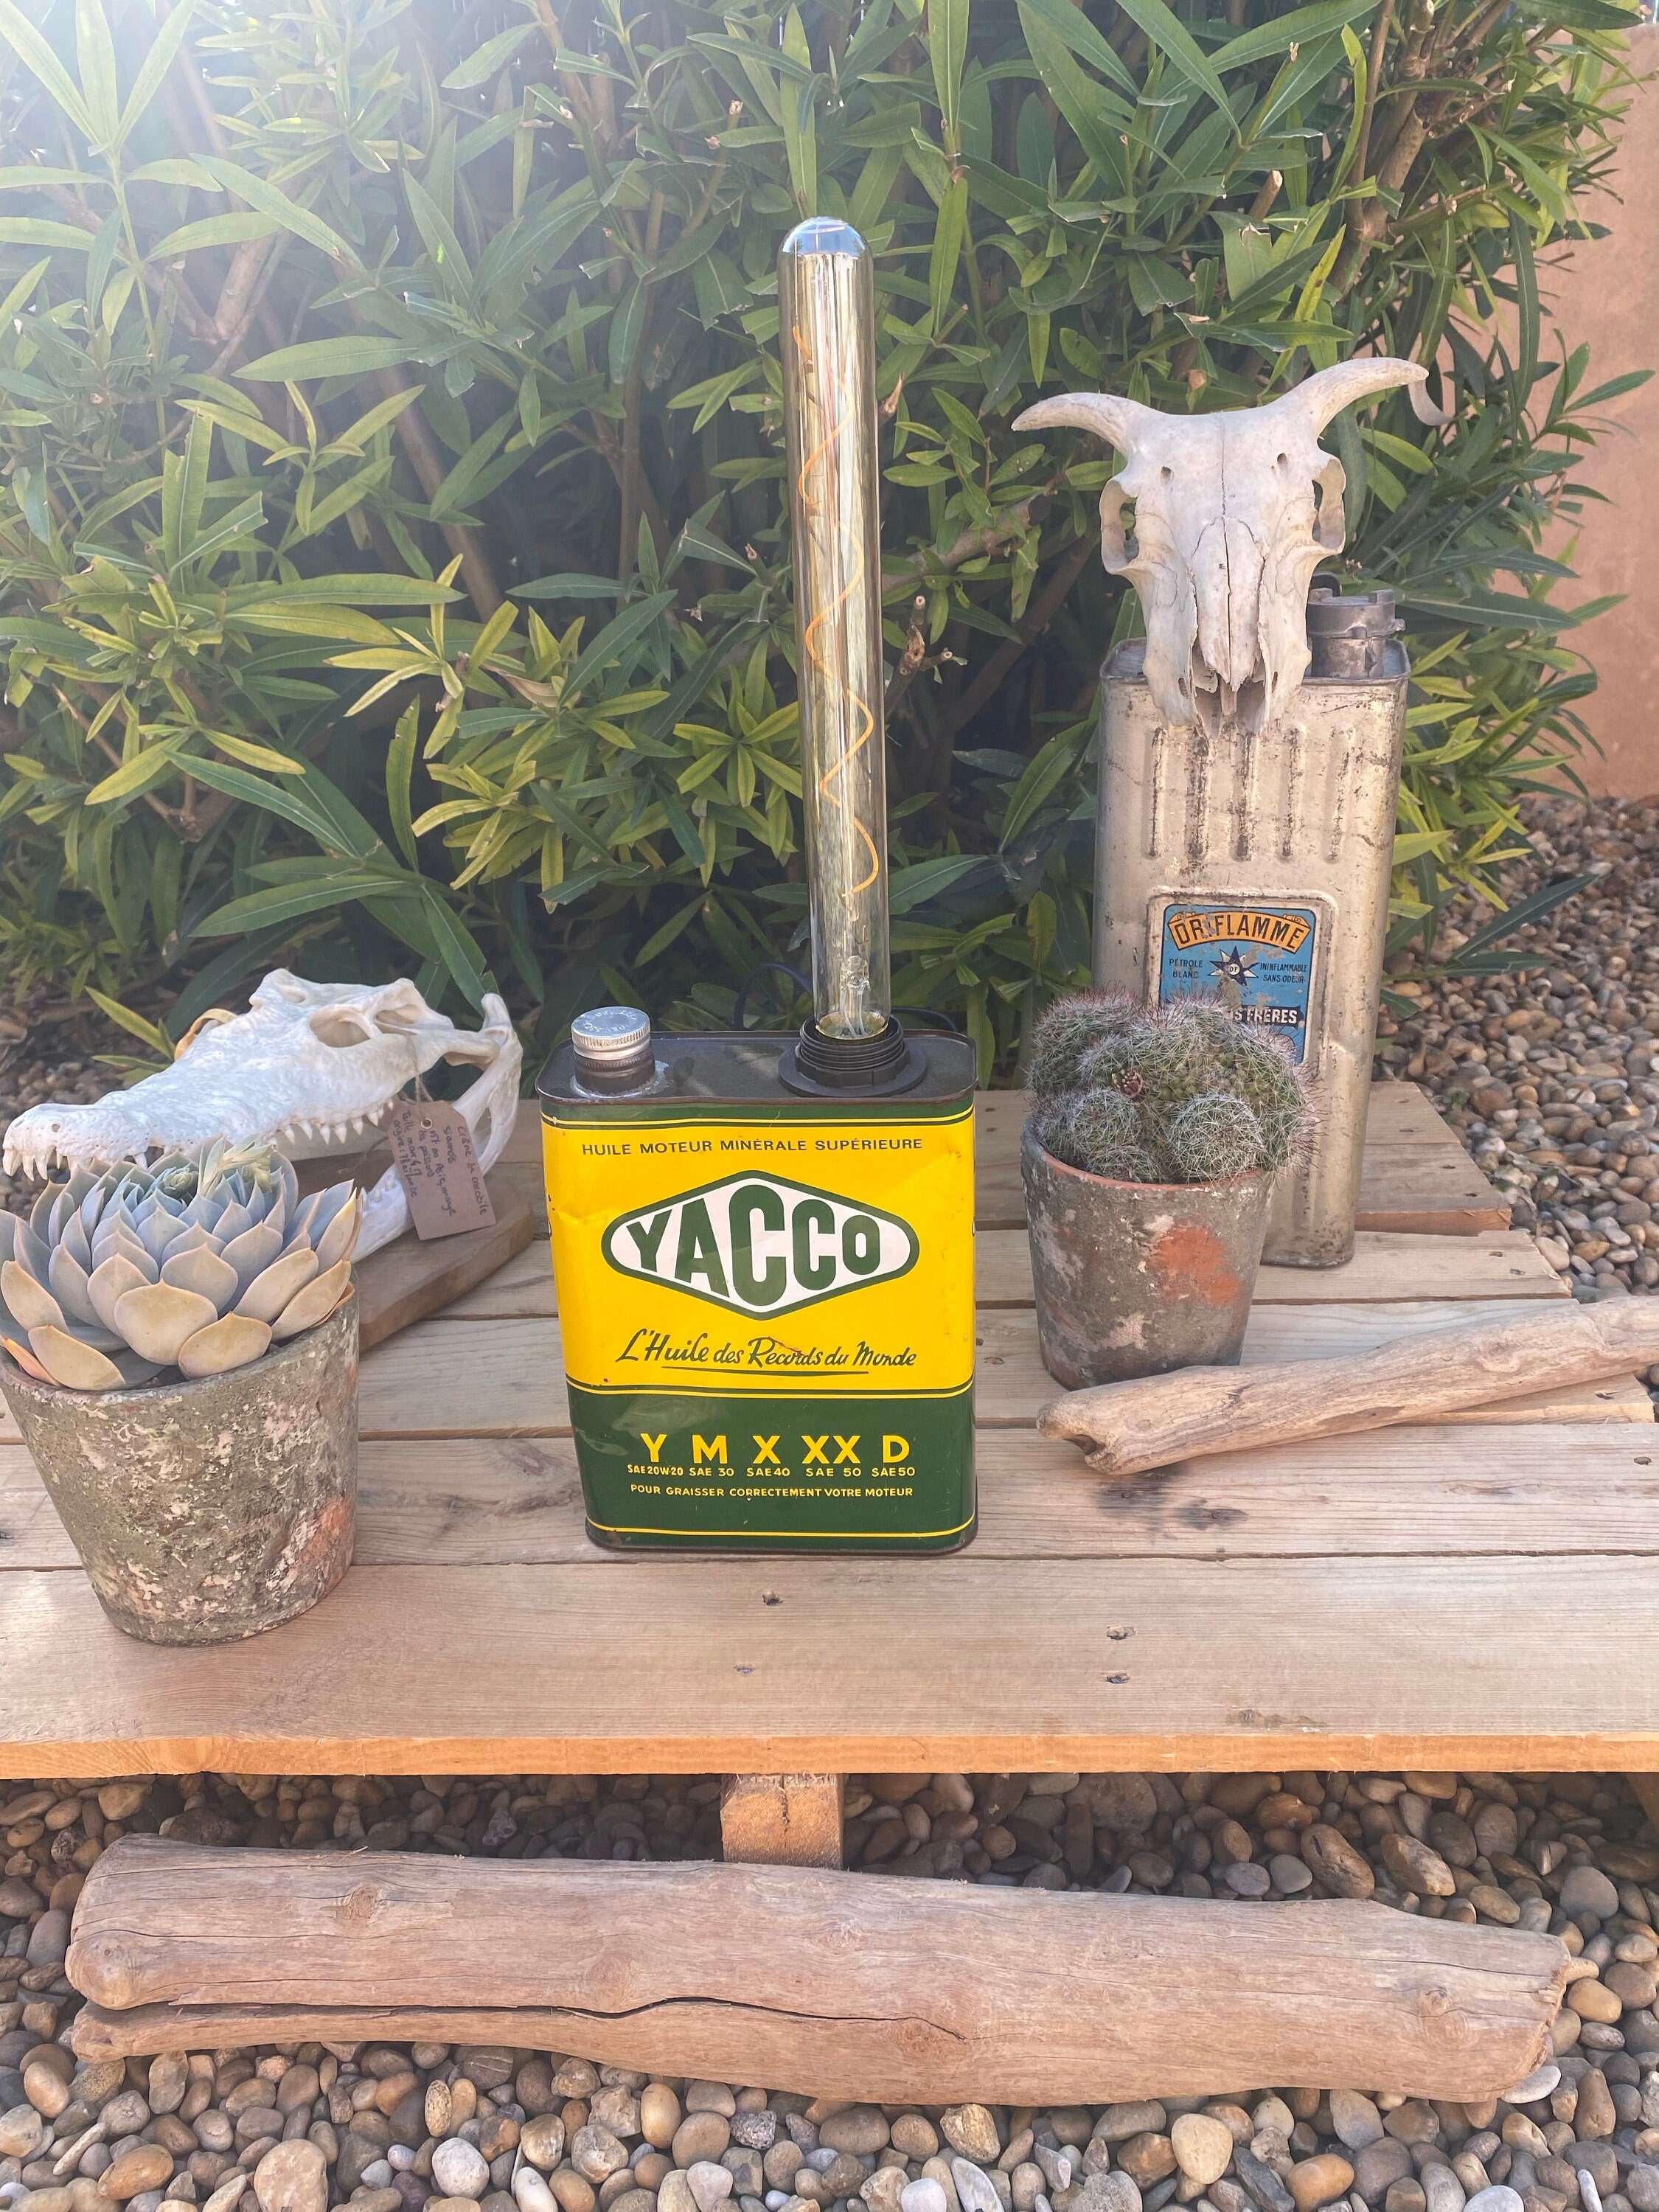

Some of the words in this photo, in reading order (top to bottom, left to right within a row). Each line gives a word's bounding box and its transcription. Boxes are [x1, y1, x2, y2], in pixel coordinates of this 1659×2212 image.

[1263, 974, 1281, 983] SANS
[582, 1142, 631, 1156] HUILE
[639, 1139, 713, 1155] MOTEUR
[720, 1137, 807, 1152] MINÉRALE
[815, 1136, 923, 1151] SUPÉRIEURE
[625, 1184, 881, 1307] YACCO
[615, 1328, 709, 1363] L'Huile
[713, 1342, 745, 1364] des
[747, 1336, 824, 1368] Records
[824, 1346, 849, 1366] du
[852, 1340, 917, 1366] Monde
[640, 1433, 667, 1463] Y
[692, 1434, 728, 1464] M
[752, 1435, 782, 1464] X
[801, 1435, 861, 1464] XX
[882, 1435, 910, 1464] D
[689, 1467, 712, 1477] SAE
[717, 1467, 734, 1477] 30
[805, 1467, 834, 1477] SAE
[843, 1467, 862, 1477] 50
[630, 1484, 661, 1495] POUR
[665, 1486, 725, 1497] GRAISSER
[729, 1488, 822, 1498] CORRECTEMENT
[824, 1488, 862, 1498] VOTRE
[865, 1487, 914, 1498] MOTEUR
